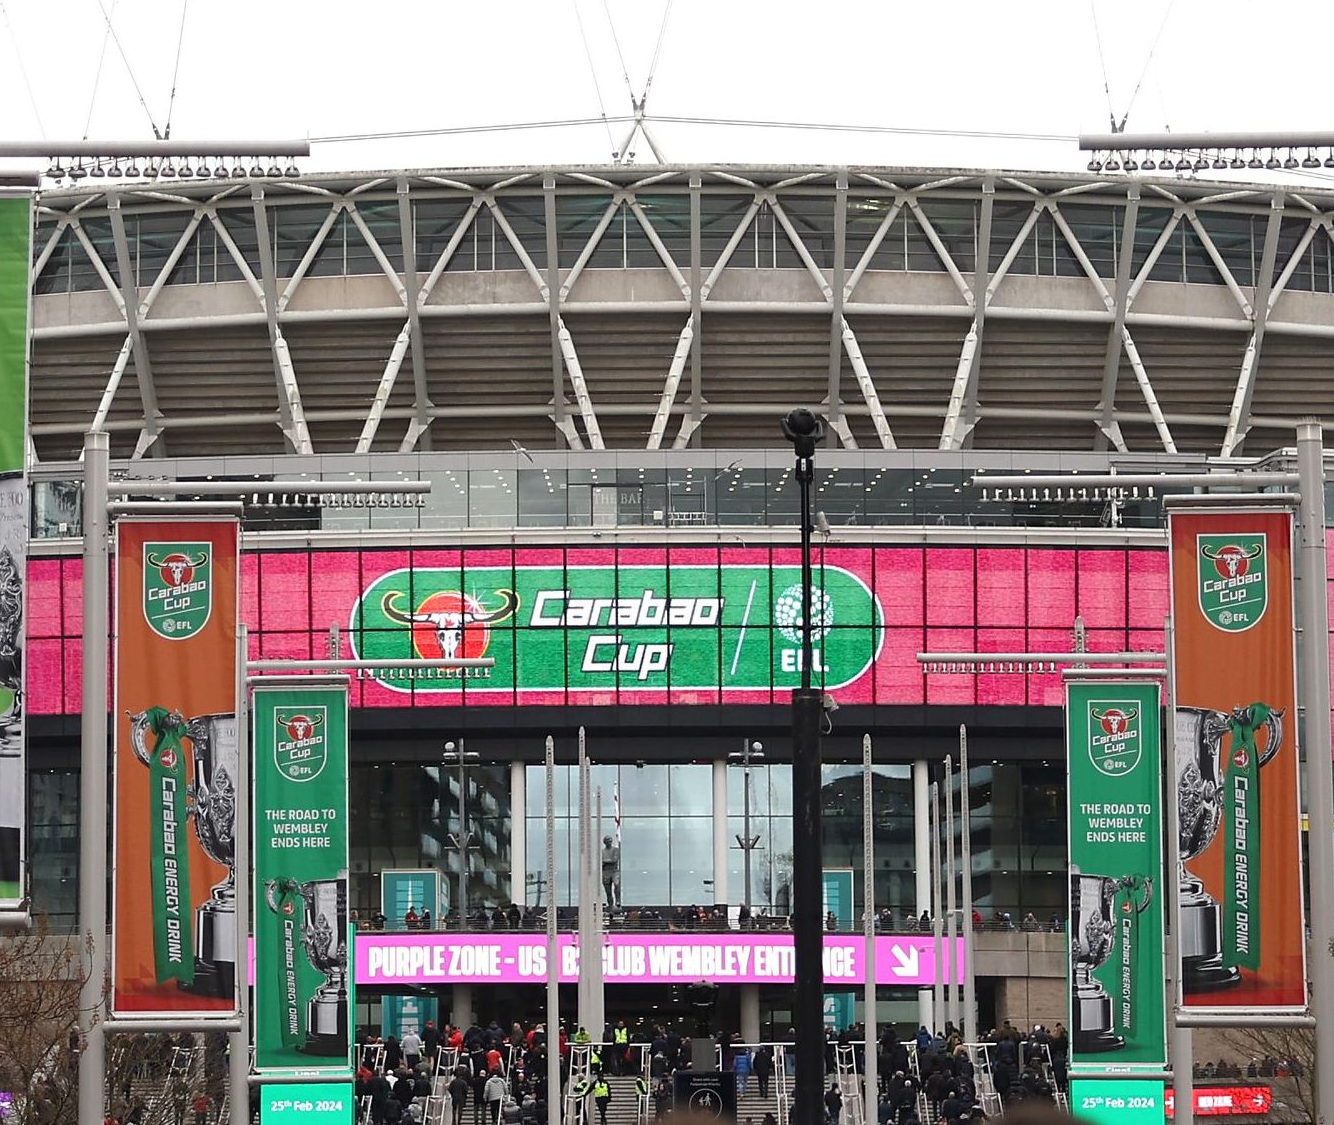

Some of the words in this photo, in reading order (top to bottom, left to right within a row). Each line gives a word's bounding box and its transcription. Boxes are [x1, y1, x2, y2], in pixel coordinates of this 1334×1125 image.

[148, 580, 207, 601] Carabao
[1203, 572, 1262, 593] Carabao
[163, 596, 191, 611] Cup
[1219, 588, 1247, 603] Cup
[530, 590, 726, 627] Carabao
[1233, 613, 1250, 622] EFL
[176, 621, 192, 630] EFL
[581, 635, 674, 680] Cup
[278, 735, 323, 752] Carabao
[1092, 730, 1138, 746] Carabao
[1104, 742, 1126, 754] Cup
[290, 748, 311, 760] Cup
[162, 776, 178, 856] Carabao
[265, 810, 286, 820] THE
[289, 809, 319, 820] ROAD
[322, 809, 336, 819] TO
[1080, 804, 1101, 814] THE
[1104, 804, 1134, 814] ROAD
[1137, 804, 1151, 814] TO
[1234, 775, 1250, 851] Carabao
[273, 823, 328, 834] WEMBLEY
[1088, 818, 1143, 828] WEMBLEY
[271, 837, 300, 848] ENDS
[303, 837, 331, 848] HERE
[1086, 831, 1115, 842] ENDS
[1118, 831, 1146, 842] HERE
[164, 858, 180, 916] ENERGY
[1235, 853, 1249, 911] ENERGY
[167, 918, 182, 964] DRINK
[1122, 919, 1132, 965] Carabao
[1236, 911, 1249, 955] DRINK
[284, 919, 295, 969] Carabao
[368, 946, 446, 977] PURPLE
[448, 945, 502, 976] ZONE
[518, 945, 547, 976] US
[648, 944, 751, 977] WEMBLEY
[286, 970, 297, 1006] ENERGY
[1122, 966, 1131, 1001] ENERGY
[288, 1007, 299, 1036] DRINK
[1122, 1002, 1131, 1029] DRINK
[270, 1099, 292, 1112] 25th
[293, 1100, 313, 1112] Feb
[315, 1100, 343, 1112] 2024
[1082, 1096, 1104, 1109] 25th
[1105, 1097, 1125, 1108] Feb
[1127, 1097, 1155, 1108] 2024
